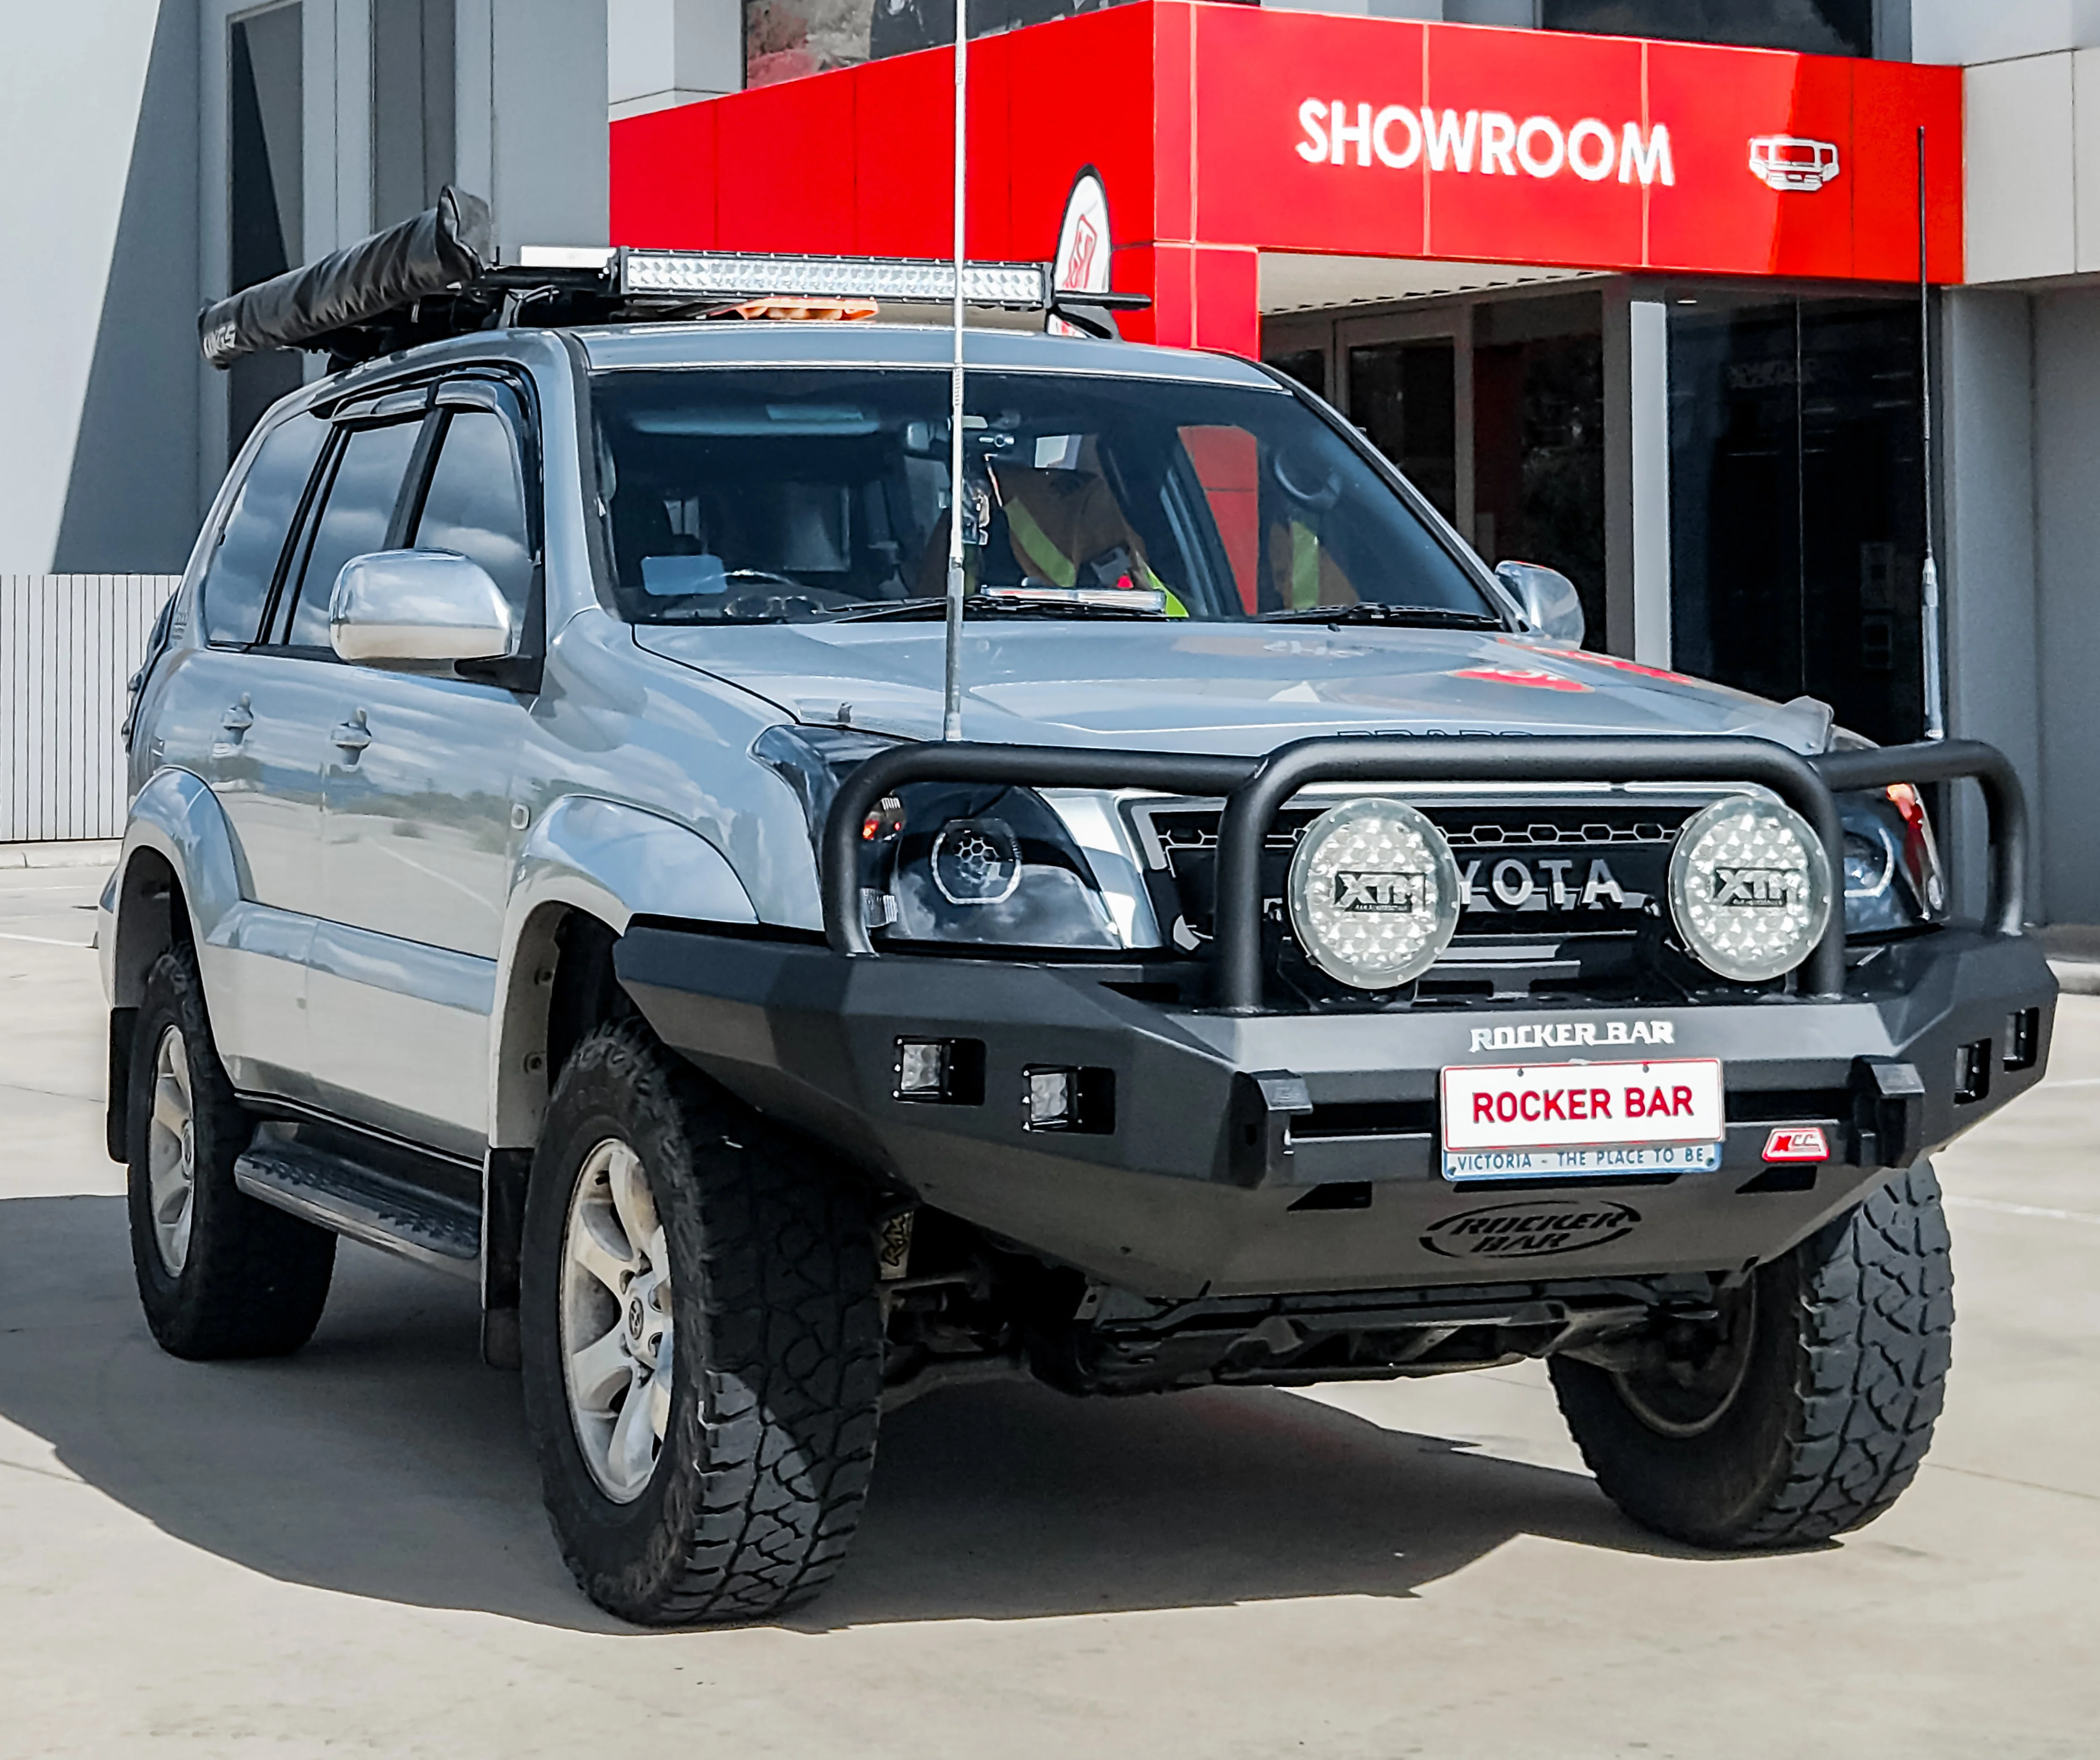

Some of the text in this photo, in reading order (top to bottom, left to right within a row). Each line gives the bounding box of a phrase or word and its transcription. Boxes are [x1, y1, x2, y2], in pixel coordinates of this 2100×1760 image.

[1295, 97, 1676, 187] SHOWROOM
[1459, 859, 1624, 905] YOTA
[1468, 1020, 1675, 1053] ROCKER BAR
[1473, 1085, 1694, 1123] ROCKER BAR
[1456, 1152, 1532, 1171] VICTORIA
[1557, 1150, 1586, 1167] THE
[1597, 1149, 1648, 1166] PLACE
[1654, 1147, 1676, 1163] TO
[1684, 1147, 1704, 1162] BE
[1449, 1212, 1626, 1235] ROCKER
[1470, 1233, 1571, 1253] BAR
